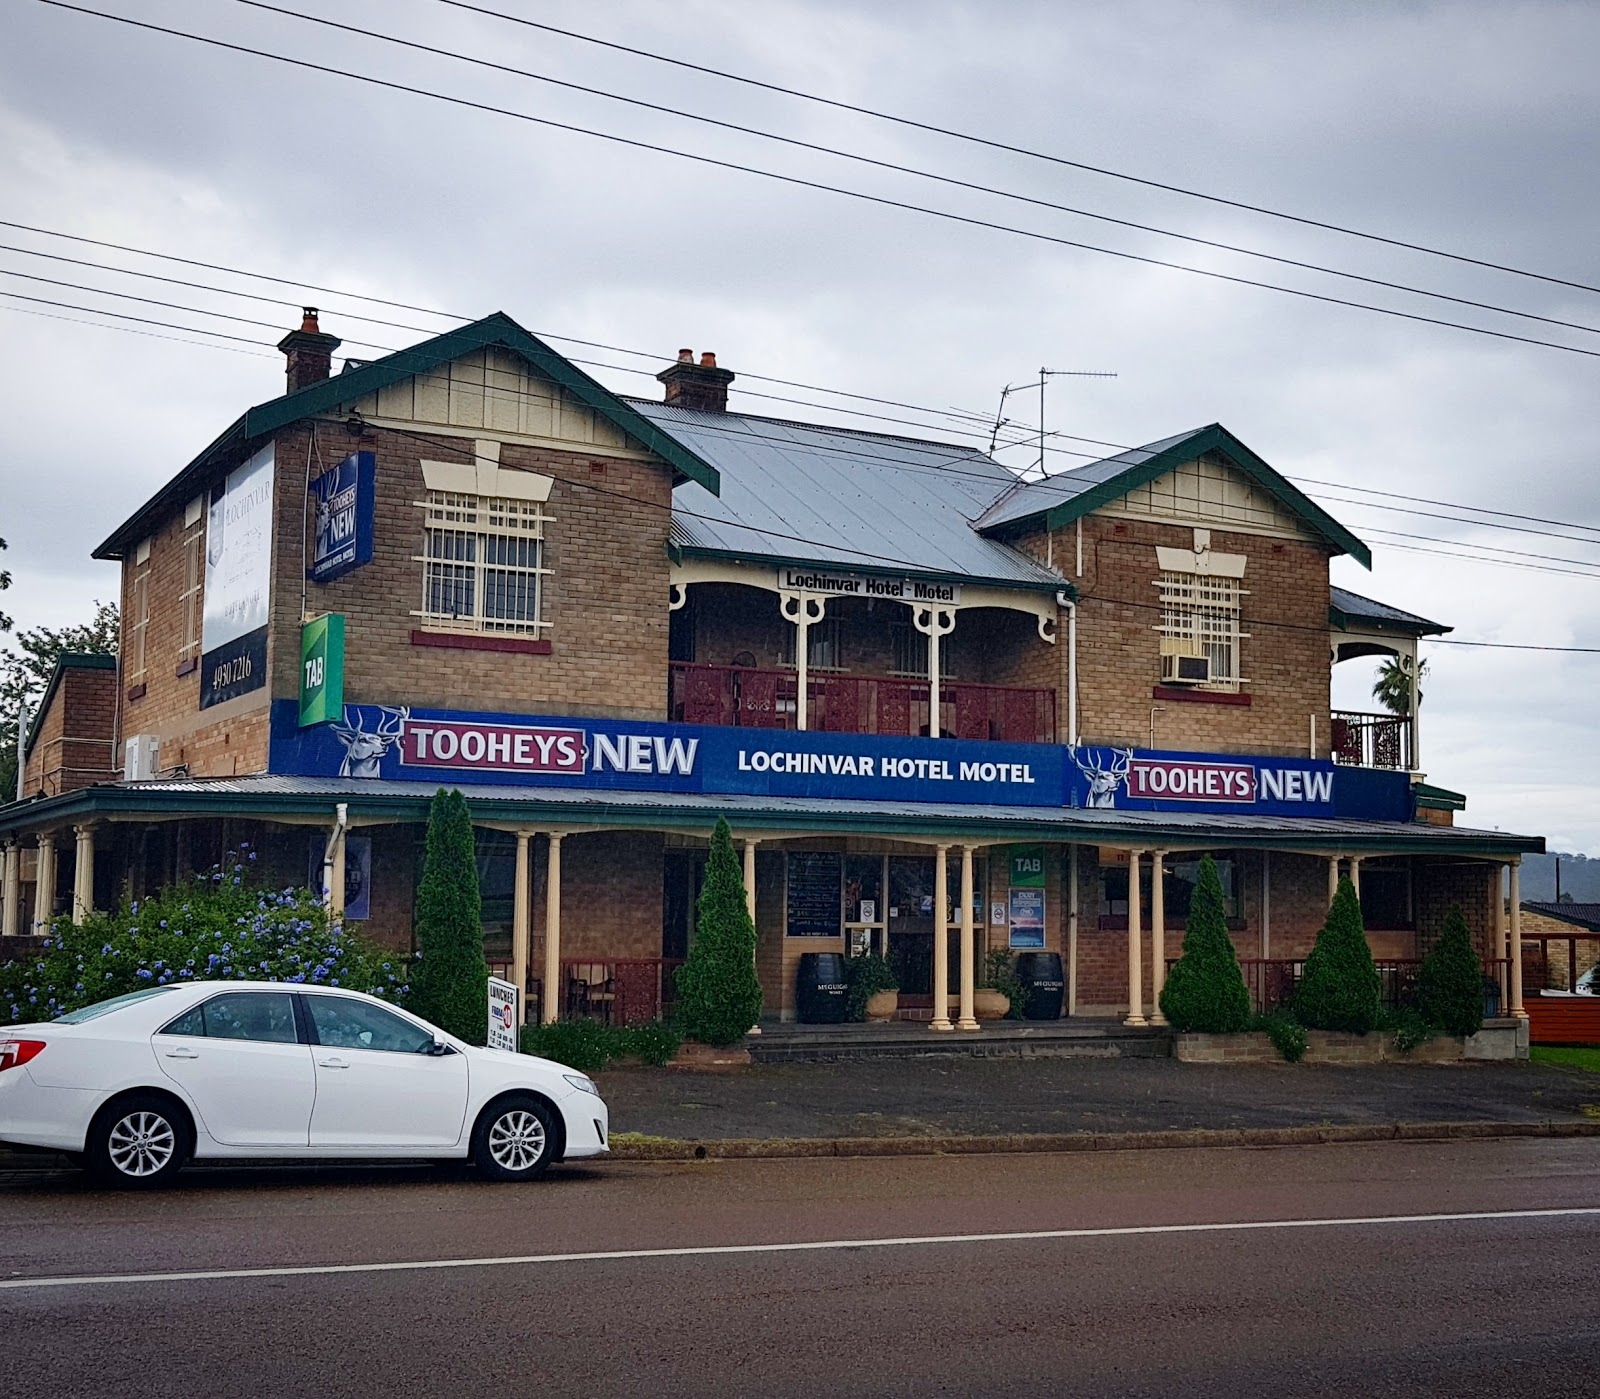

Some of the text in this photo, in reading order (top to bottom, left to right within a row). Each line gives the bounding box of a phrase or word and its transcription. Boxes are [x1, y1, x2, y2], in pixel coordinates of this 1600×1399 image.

[333, 488, 355, 512] TOOHEYS
[330, 506, 355, 545] NEW
[786, 571, 861, 593] Lochinvar
[865, 578, 904, 597] Hotel
[914, 583, 954, 601] Motel
[213, 653, 252, 691] 4930 7216
[305, 657, 323, 689] TAB
[410, 727, 698, 775] TOOHEYS NEW
[738, 750, 1035, 784] LOCHINVAR HOTEL MOTEL
[1133, 766, 1334, 803] TOOHEYS NEW
[1015, 858, 1041, 872] TAB
[490, 985, 513, 1005] LUNCHES
